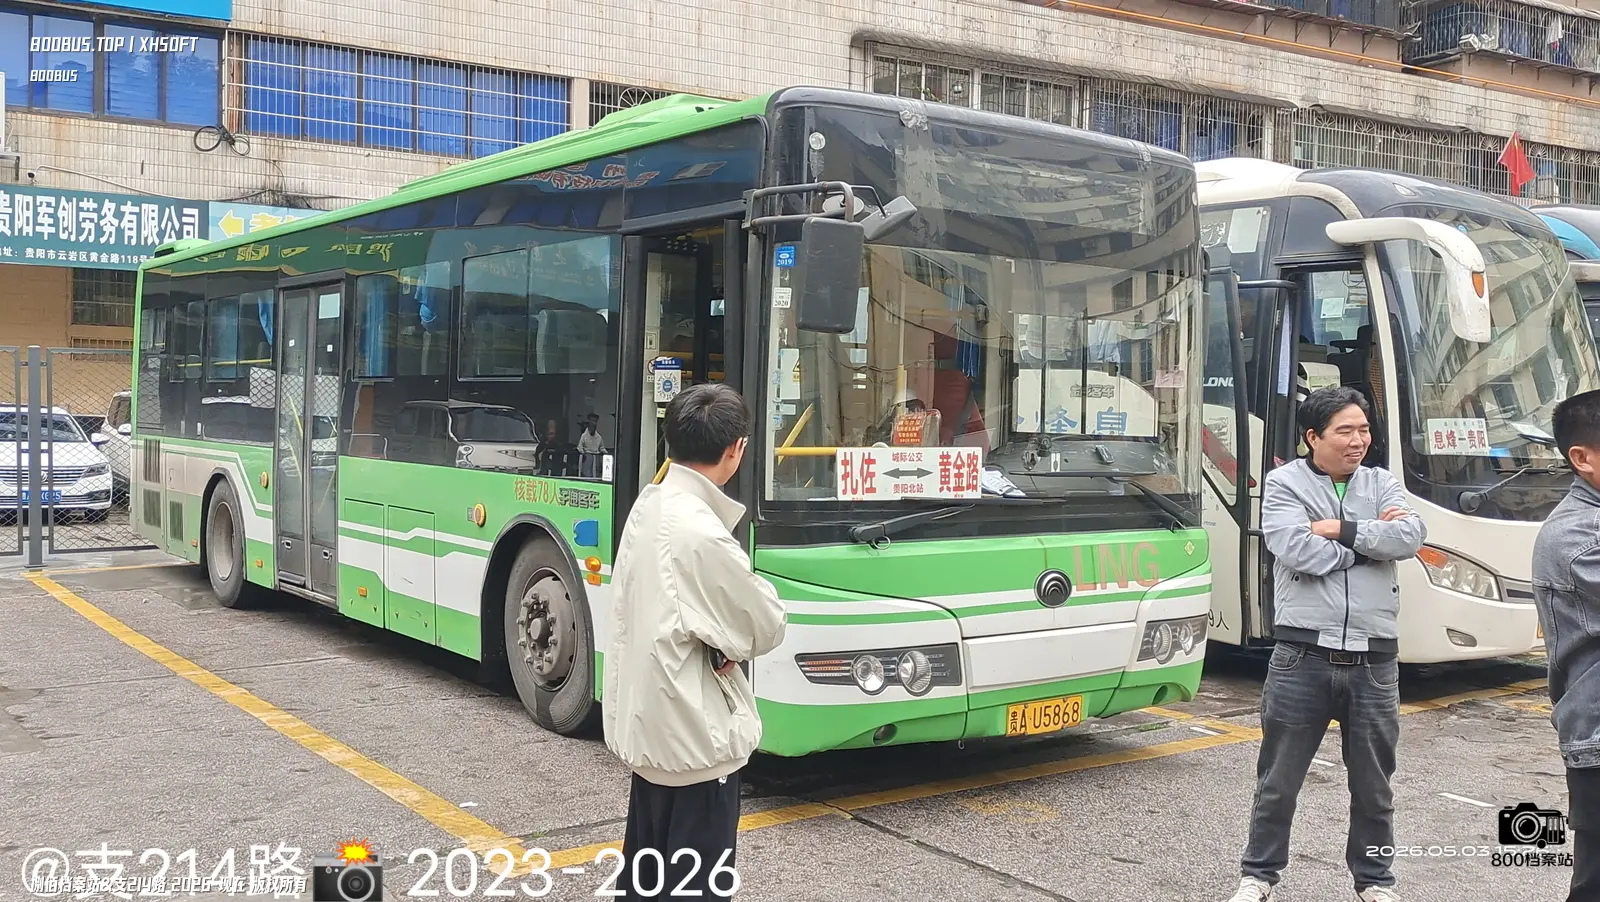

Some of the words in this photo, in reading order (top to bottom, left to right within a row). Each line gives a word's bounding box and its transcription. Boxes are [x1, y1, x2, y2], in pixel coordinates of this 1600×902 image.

[0, 190, 199, 246] 贵阳军创劳务有限公司
[841, 451, 877, 496] 扎佐
[892, 452, 923, 462] 城际公交
[938, 450, 979, 493] 黄金路
[514, 476, 560, 506] 核载78人
[893, 483, 924, 494] 贵阳北站
[1072, 541, 1159, 592] LNG
